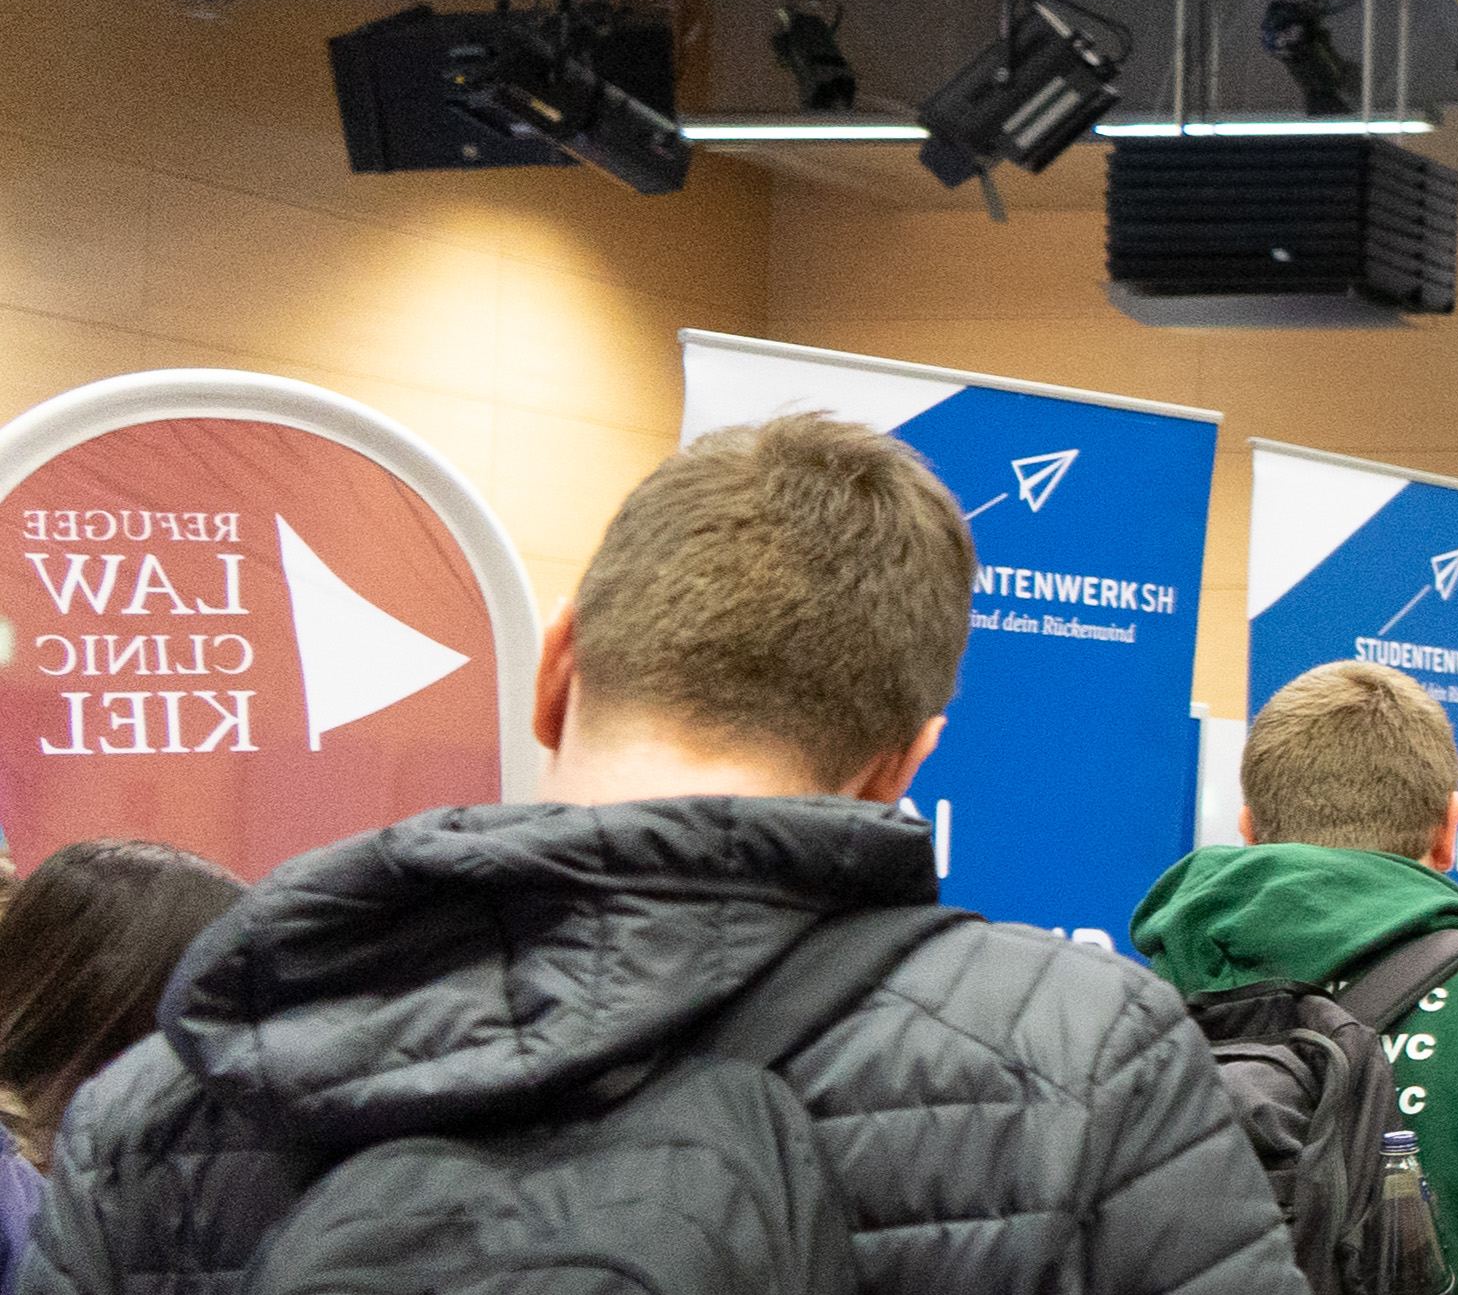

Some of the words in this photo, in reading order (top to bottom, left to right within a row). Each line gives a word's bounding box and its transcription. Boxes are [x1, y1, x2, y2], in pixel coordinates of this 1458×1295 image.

[972, 565, 1175, 614] NTENWERKSH
[970, 608, 1001, 630] ind
[1002, 610, 1039, 634] dein
